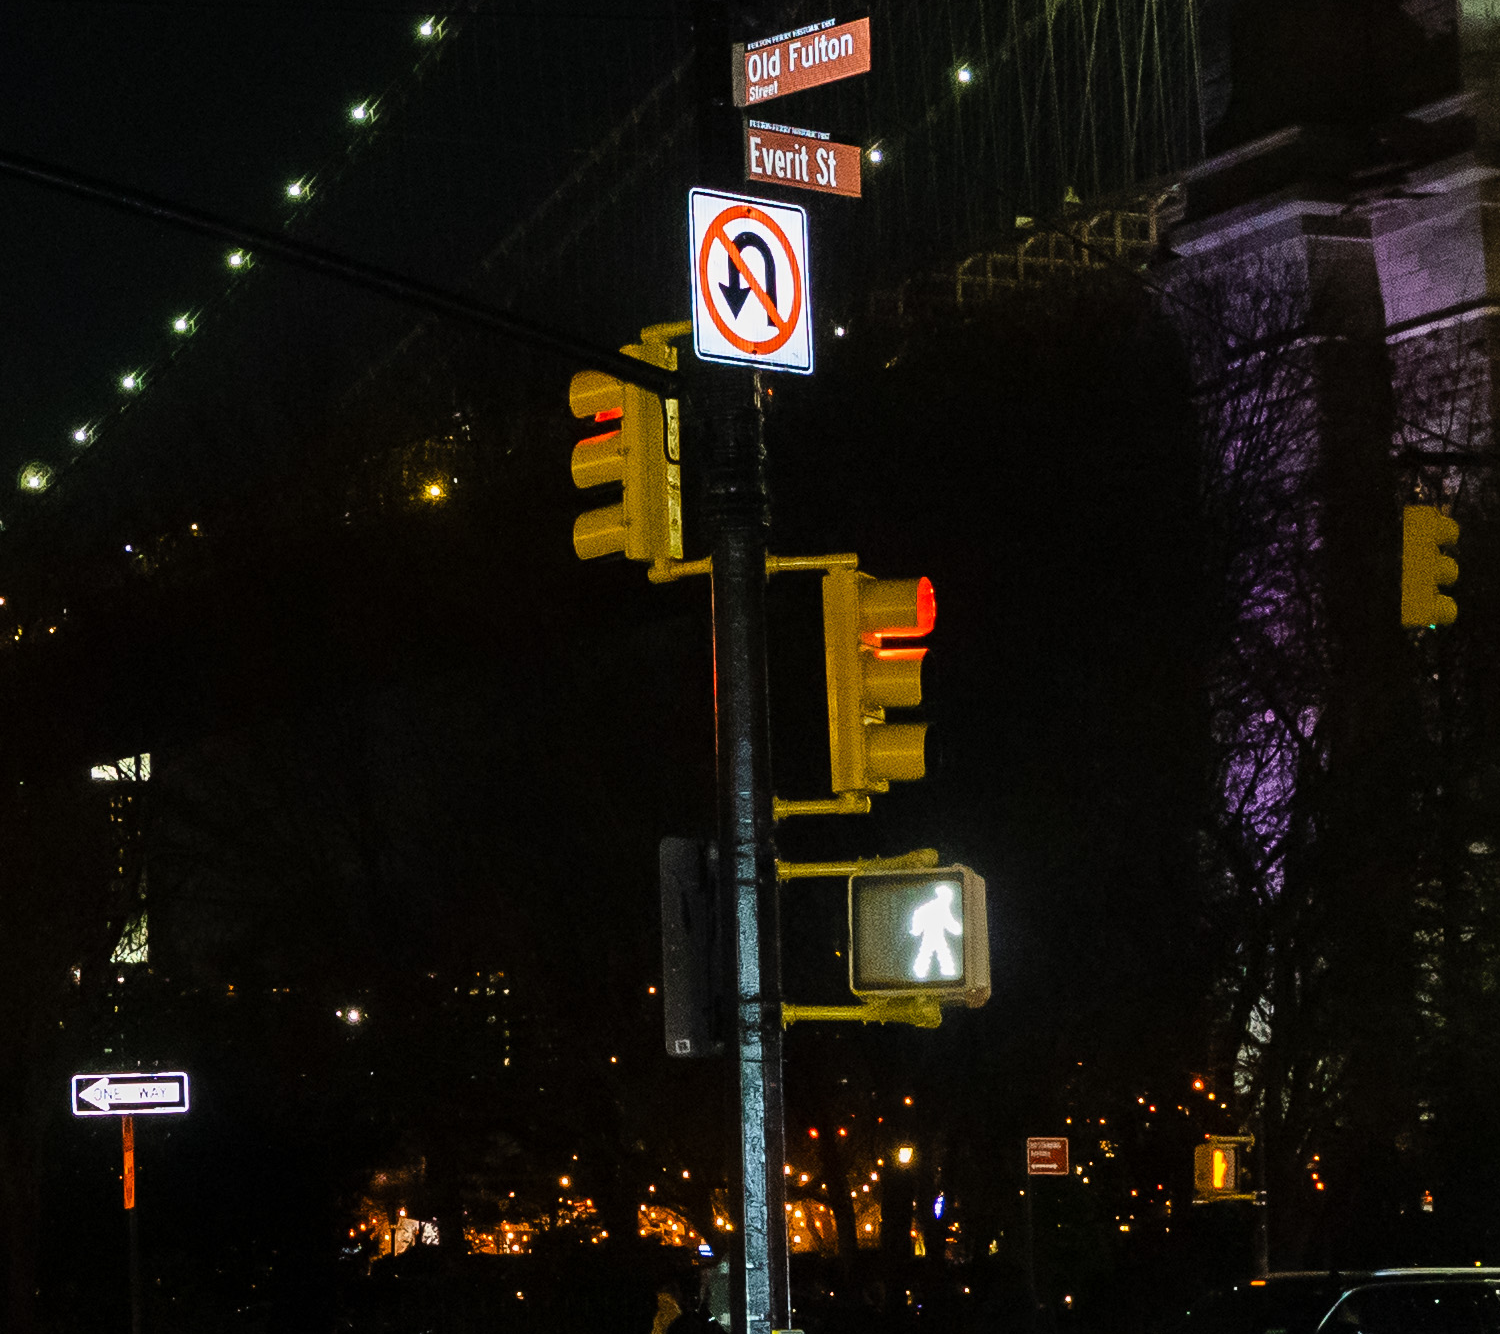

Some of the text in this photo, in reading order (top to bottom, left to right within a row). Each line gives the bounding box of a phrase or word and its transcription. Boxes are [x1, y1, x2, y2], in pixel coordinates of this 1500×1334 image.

[748, 33, 853, 82] Old Fulton
[750, 80, 778, 101] Street
[750, 136, 837, 187] Everit St
[94, 1087, 167, 1102] ONE WAY
